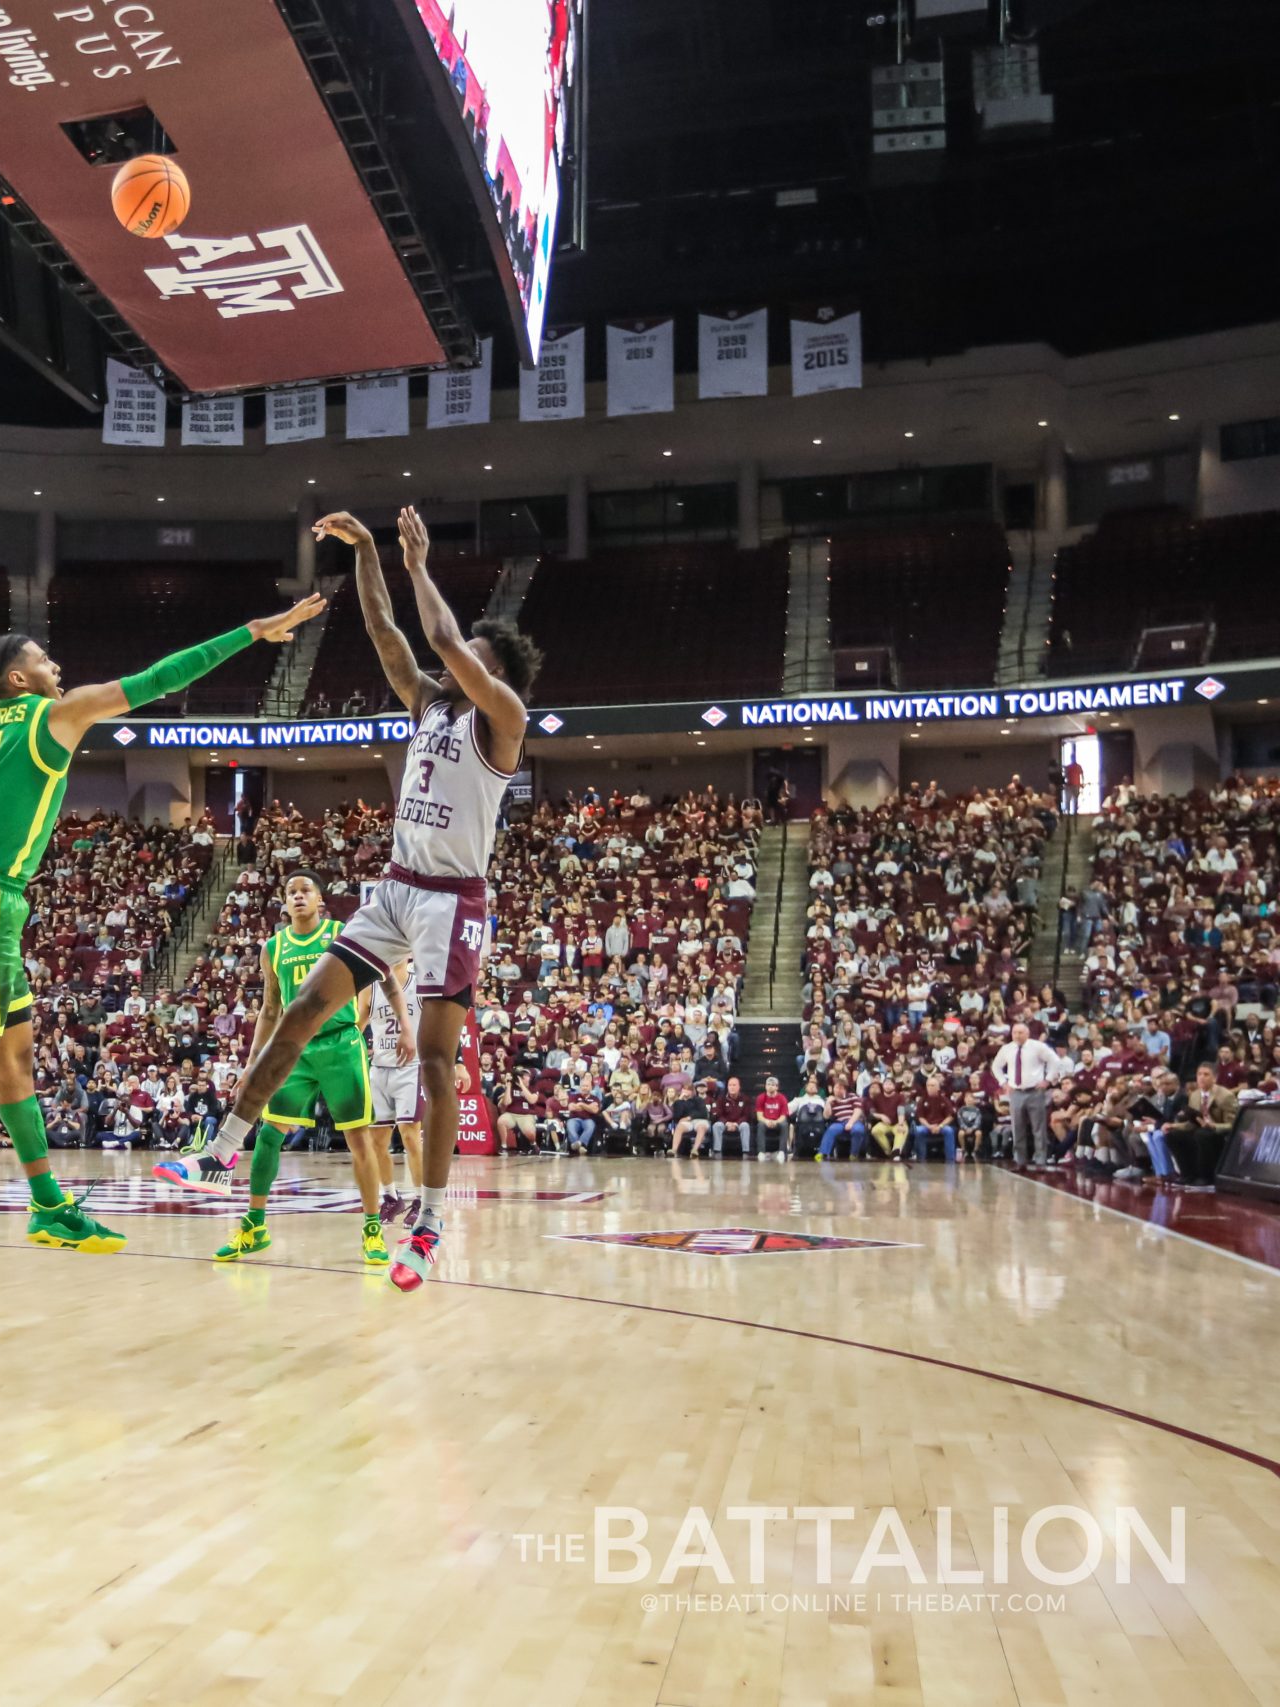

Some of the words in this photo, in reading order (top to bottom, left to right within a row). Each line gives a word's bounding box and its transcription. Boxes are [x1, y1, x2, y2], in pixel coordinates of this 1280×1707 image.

[106, 0, 181, 70] CAN
[804, 348, 849, 370] 2015
[742, 700, 858, 725] NATIONAL
[866, 694, 997, 720] INVITATION
[1004, 681, 1185, 714] TOURNAMENT
[150, 727, 254, 745] NATIONAL
[261, 722, 373, 744] INVITATION
[419, 760, 434, 794] 3
